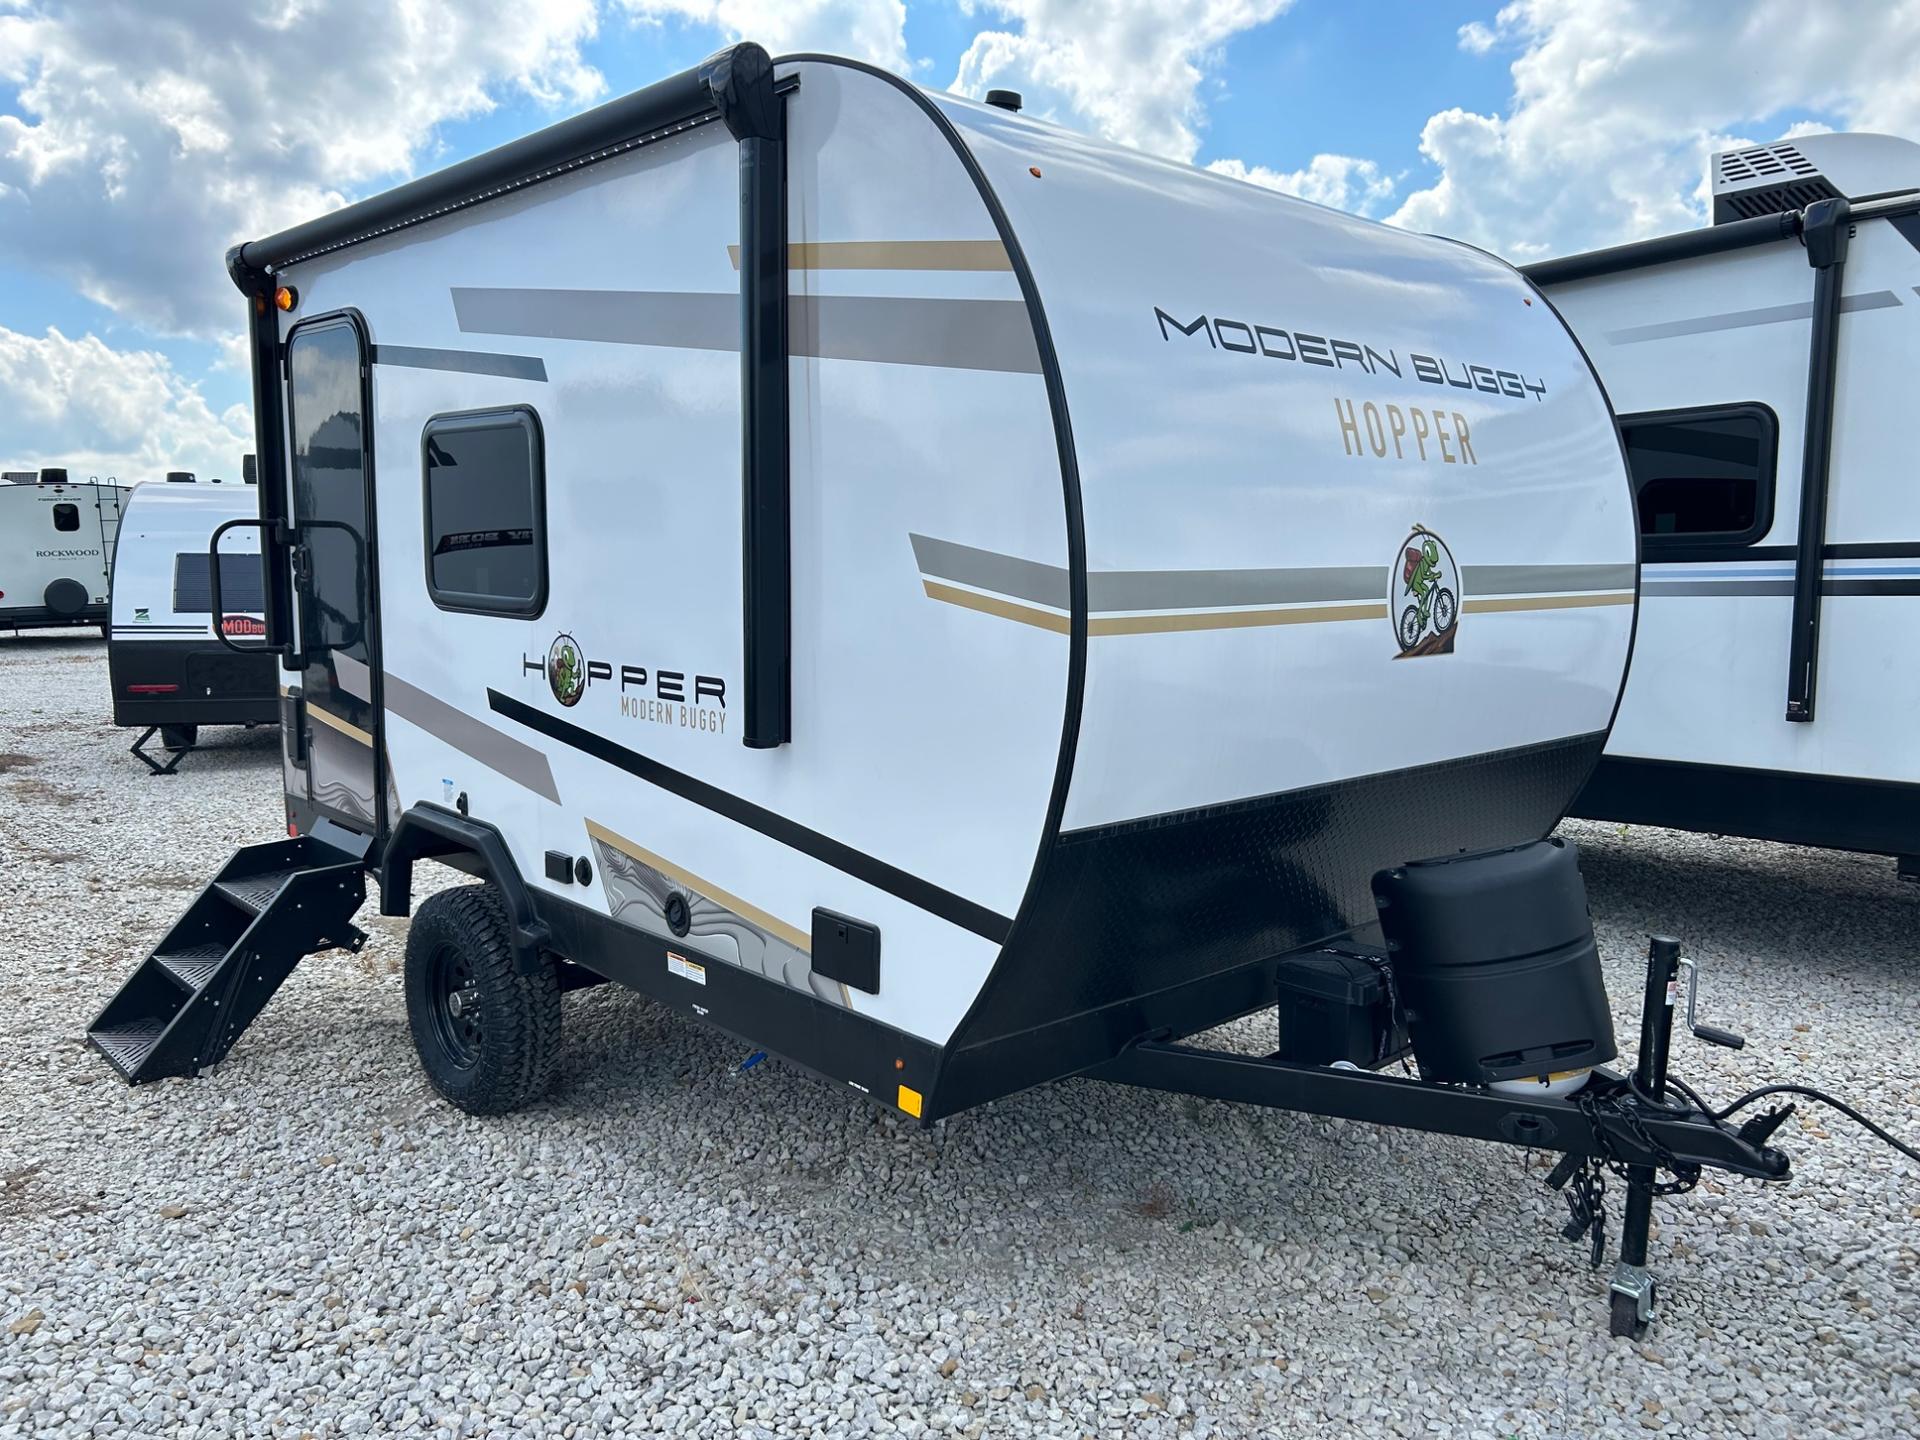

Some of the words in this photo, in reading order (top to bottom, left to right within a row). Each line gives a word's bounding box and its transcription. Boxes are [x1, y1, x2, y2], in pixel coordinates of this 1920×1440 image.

[1153, 306, 1402, 379] MODERN
[1410, 353, 1547, 402] BUGGY
[1334, 398, 1477, 465] HOPPER
[36, 549, 99, 558] ROCKWOOD
[223, 619, 266, 634] MODBU
[621, 695, 673, 725] MODERN
[679, 705, 727, 735] BUGGY
